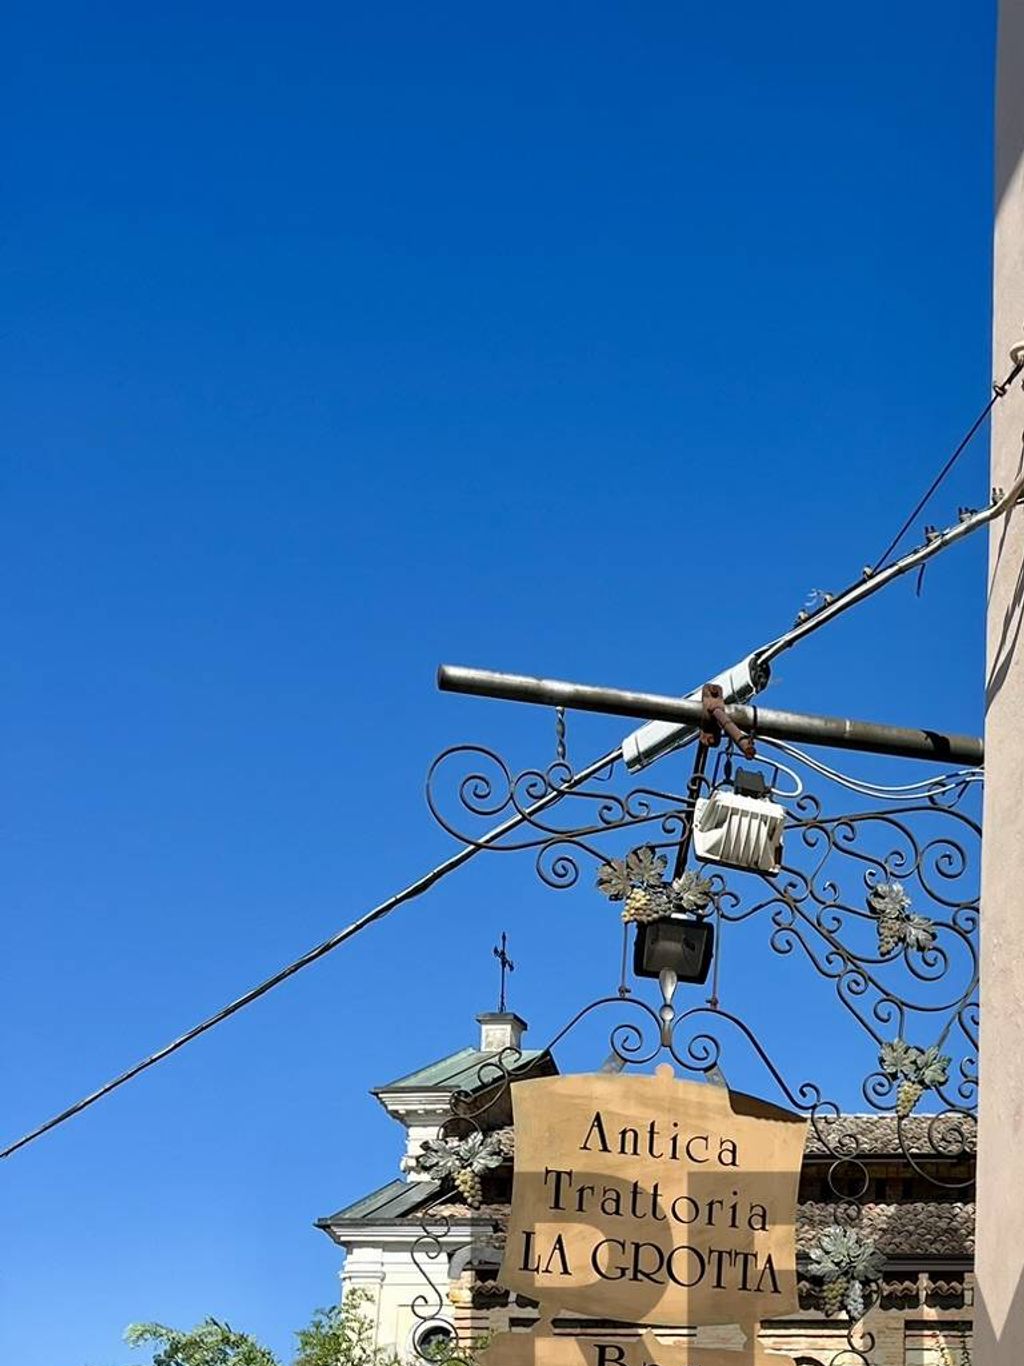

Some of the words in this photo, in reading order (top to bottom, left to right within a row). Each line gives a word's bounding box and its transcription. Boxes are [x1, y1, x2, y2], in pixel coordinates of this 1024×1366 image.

[580, 1111, 740, 1167] Antica
[544, 1166, 769, 1232] Trattoria
[518, 1230, 573, 1276] LA
[591, 1238, 782, 1295] GROTTA
